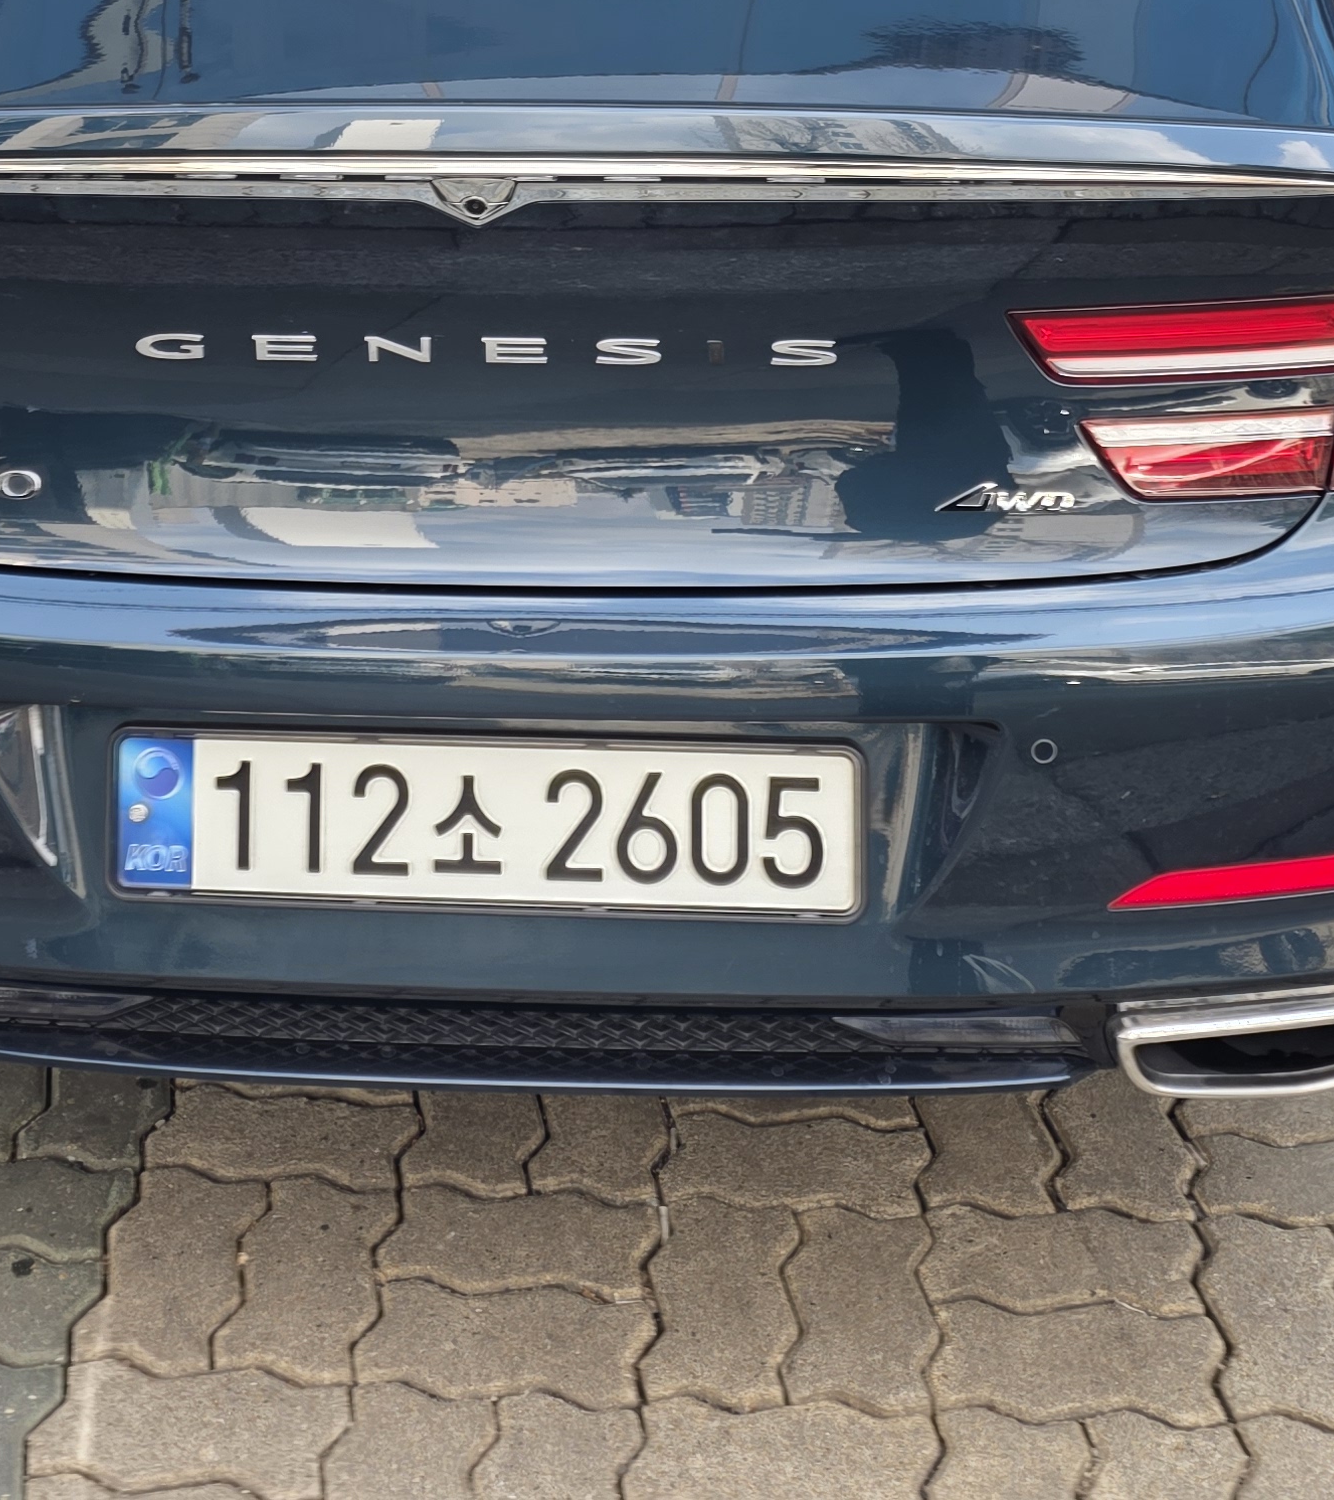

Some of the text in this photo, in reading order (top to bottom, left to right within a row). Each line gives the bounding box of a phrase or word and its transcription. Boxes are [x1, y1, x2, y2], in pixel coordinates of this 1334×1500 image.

[135, 333, 838, 367] GENESIS
[214, 759, 825, 889] 112소 2605
[124, 843, 188, 873] KOR
